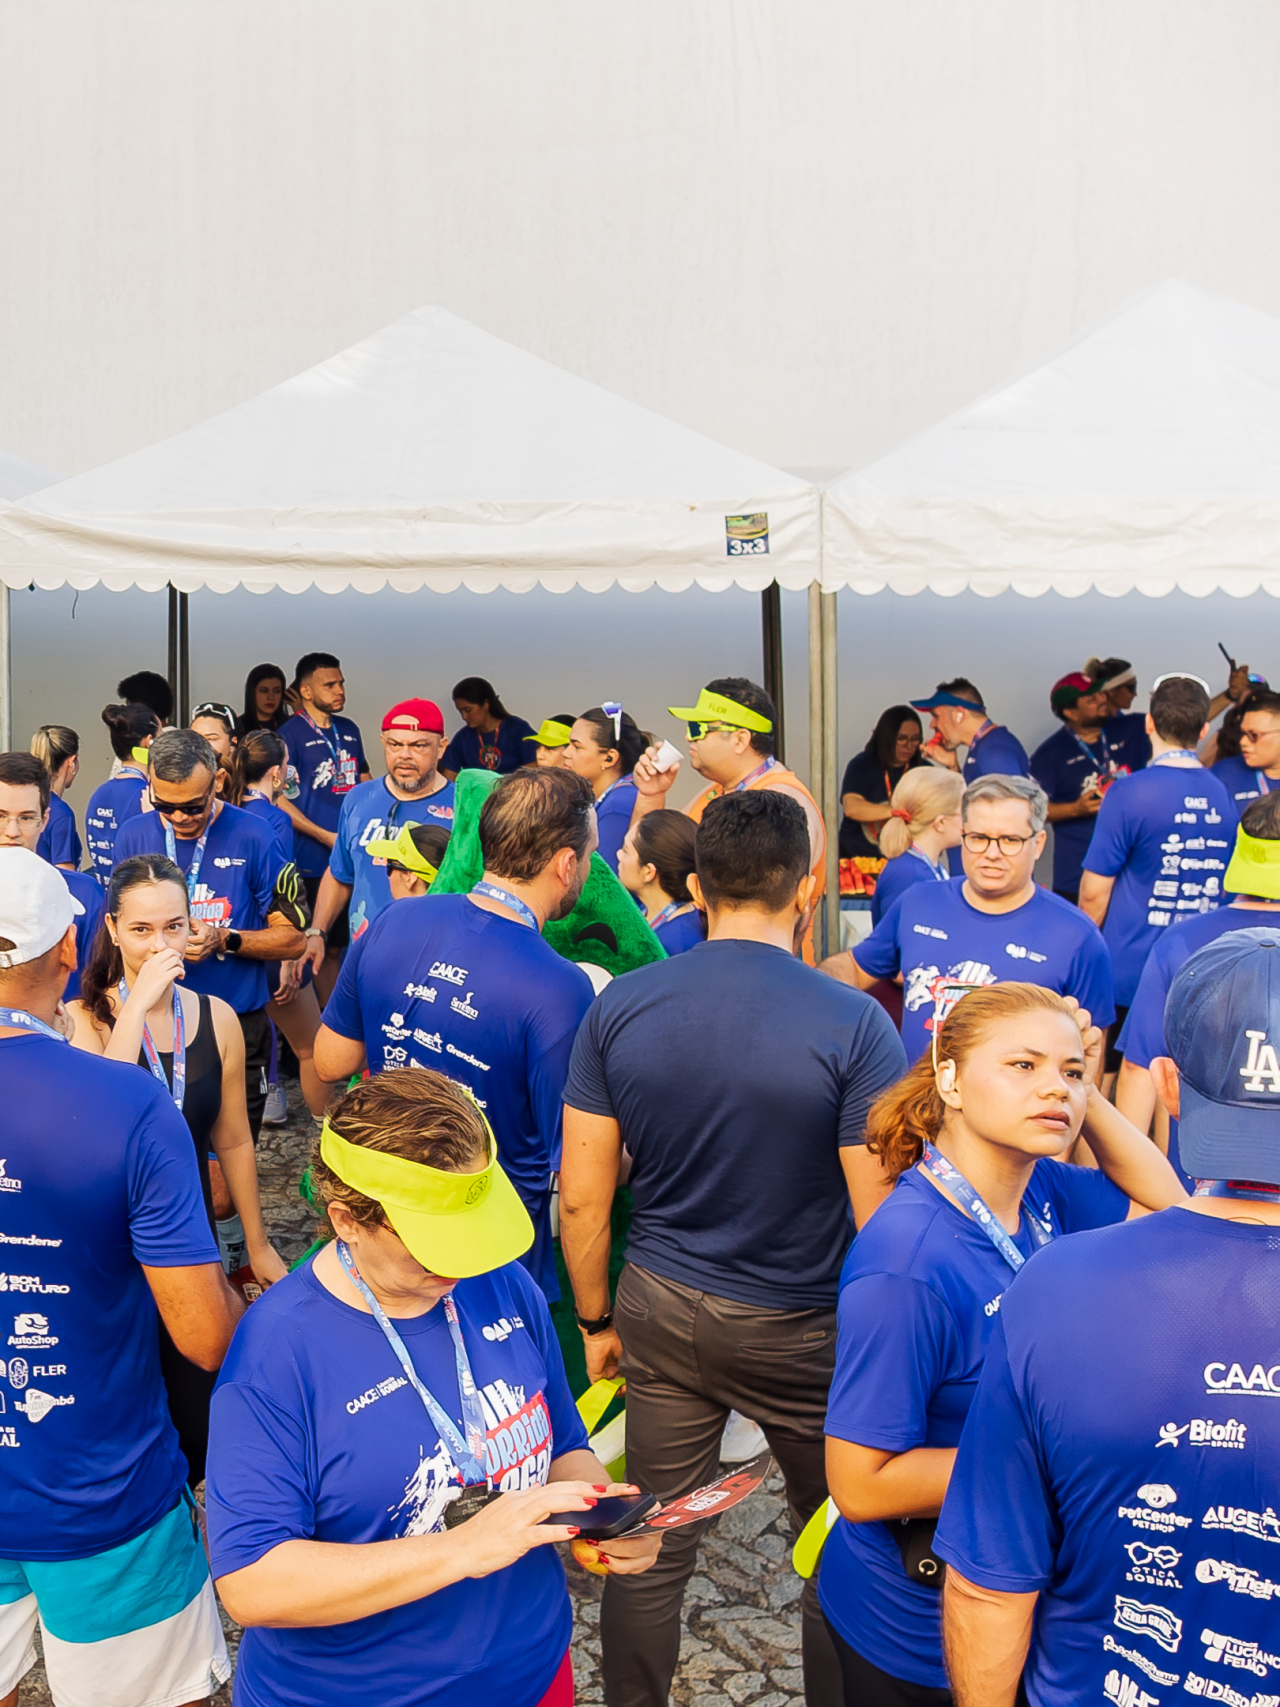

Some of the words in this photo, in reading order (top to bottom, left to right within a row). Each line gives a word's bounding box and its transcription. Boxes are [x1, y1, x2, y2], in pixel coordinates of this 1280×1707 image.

[730, 538, 766, 555] 3x3
[428, 961, 469, 984] CAACE
[9, 1275, 40, 1285] BOM
[9, 1284, 71, 1294] FUTURO
[7, 1335, 59, 1346] AutoShop
[32, 1364, 67, 1377] FLER
[1204, 1362, 1280, 1392] CAAC
[379, 1377, 408, 1396] SOBRAL
[346, 1389, 378, 1415] CAACE
[1189, 1418, 1248, 1442] Biofit
[1118, 1506, 1193, 1528] PetCenter
[1202, 1505, 1260, 1531] AUGE
[1125, 1572, 1183, 1589] SOBRAL
[1121, 1606, 1147, 1624] SERRA
[1225, 1640, 1280, 1669] LUCIANO
